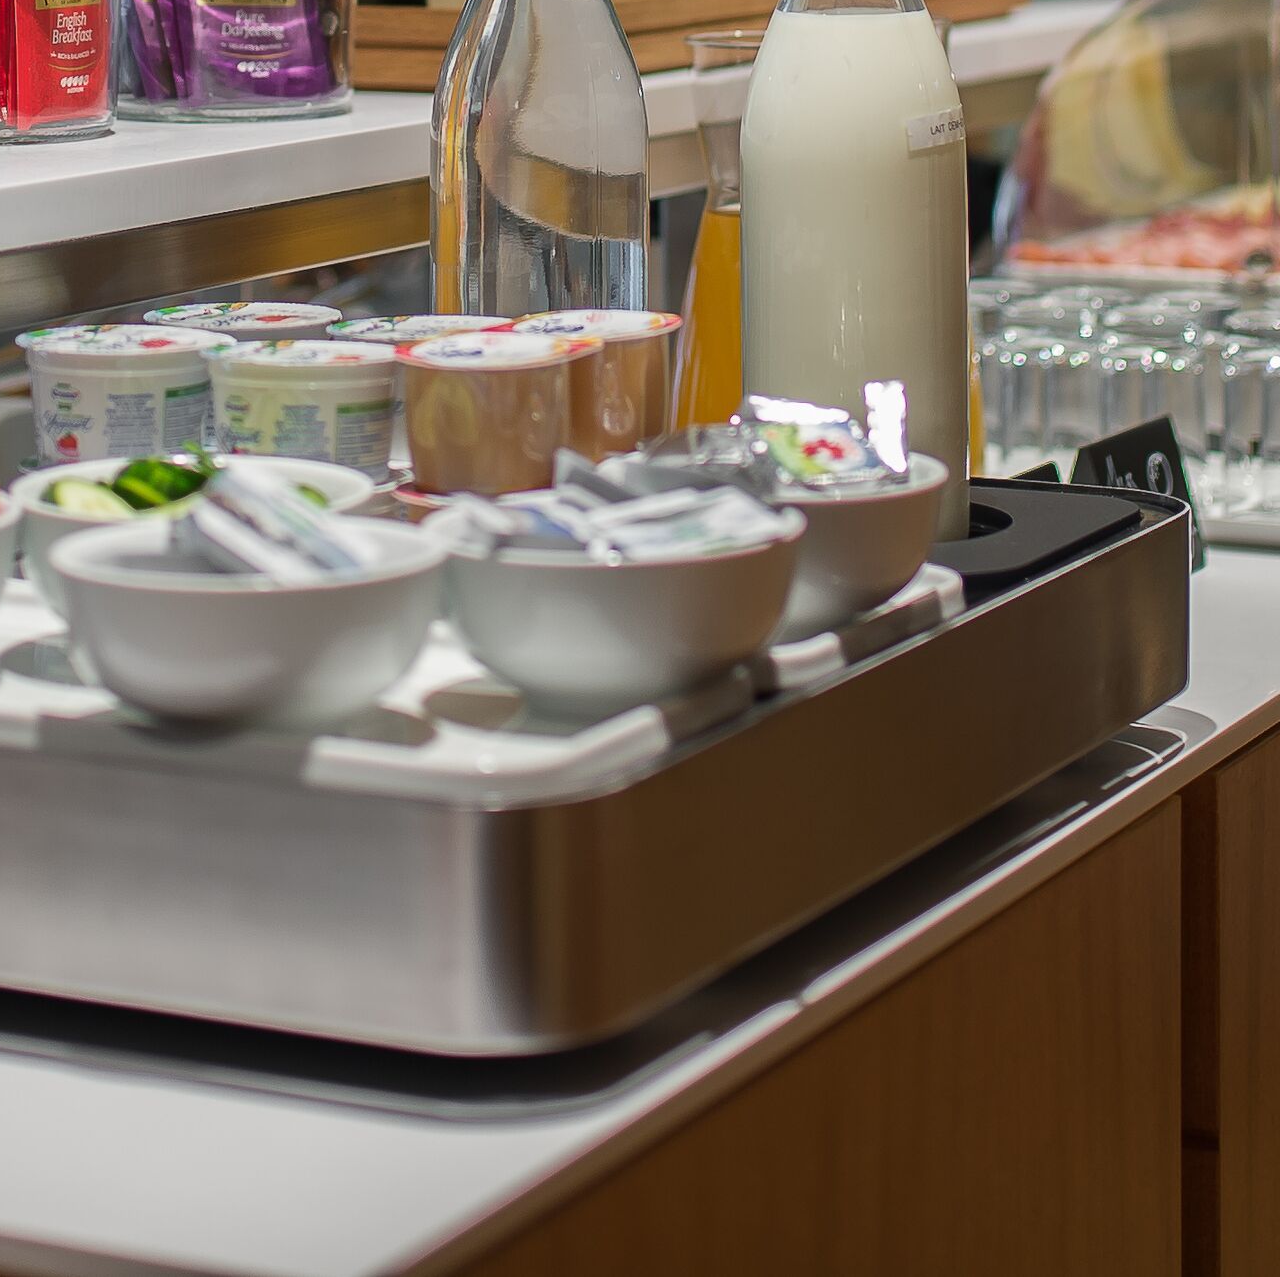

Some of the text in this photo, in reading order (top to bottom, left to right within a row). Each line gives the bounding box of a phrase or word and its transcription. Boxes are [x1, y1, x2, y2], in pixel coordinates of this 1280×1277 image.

[56, 10, 87, 30] English
[235, 9, 266, 24] Pure
[52, 27, 93, 46] Breakfast
[222, 23, 284, 40] Darjeeling
[931, 124, 945, 135] LAIT
